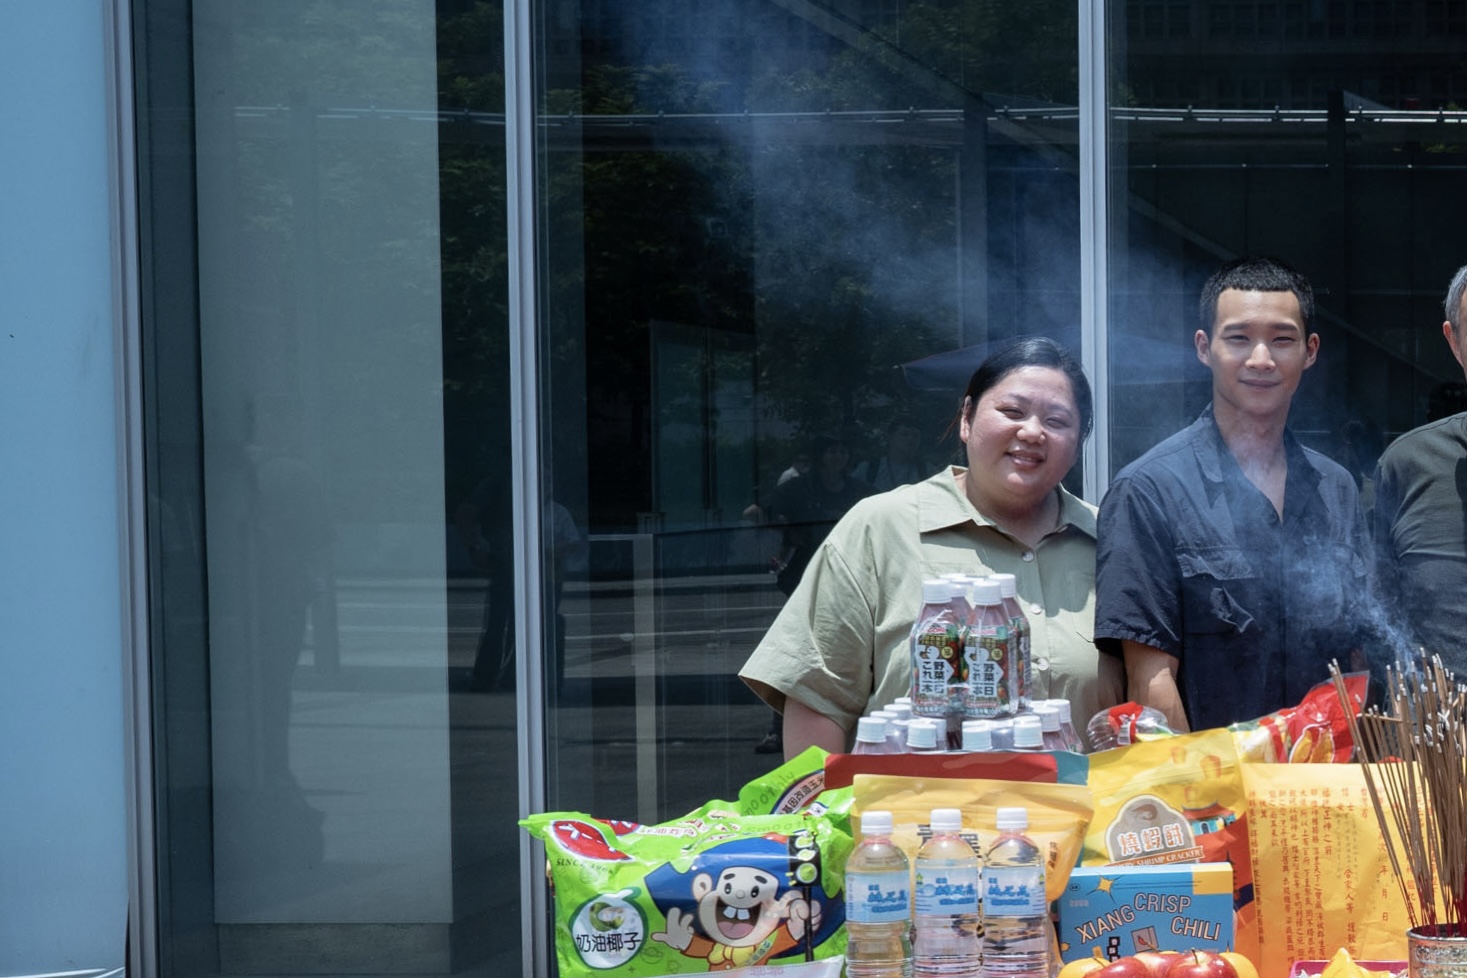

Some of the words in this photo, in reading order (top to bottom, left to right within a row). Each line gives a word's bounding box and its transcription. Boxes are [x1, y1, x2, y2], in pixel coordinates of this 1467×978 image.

[1117, 823, 1185, 857] 燒蝦餅
[1133, 891, 1192, 914] CRISP
[1075, 905, 1136, 944] XIANG
[1170, 915, 1221, 942] CHILI
[575, 931, 643, 953] 奶油椰子
